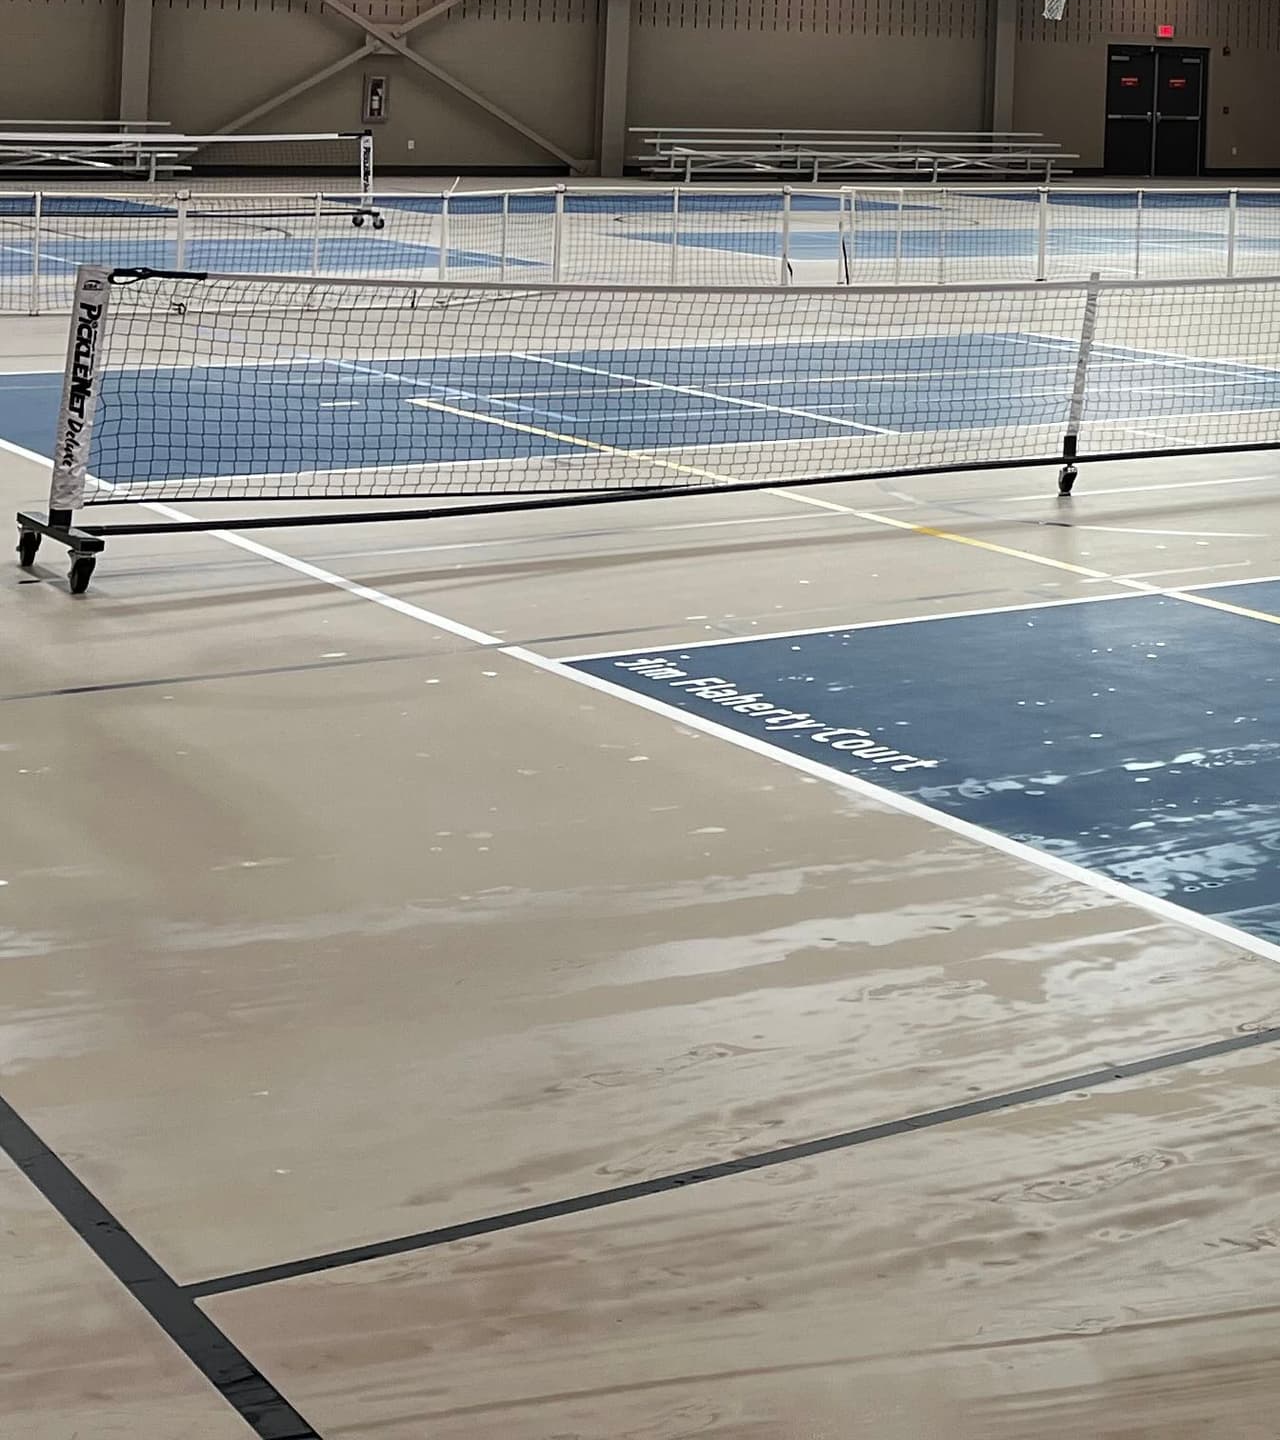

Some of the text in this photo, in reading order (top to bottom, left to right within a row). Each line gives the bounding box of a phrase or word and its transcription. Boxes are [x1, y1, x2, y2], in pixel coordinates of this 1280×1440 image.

[62, 419, 84, 468] Deluxe
[614, 658, 941, 772] Jim Flaherty Court
